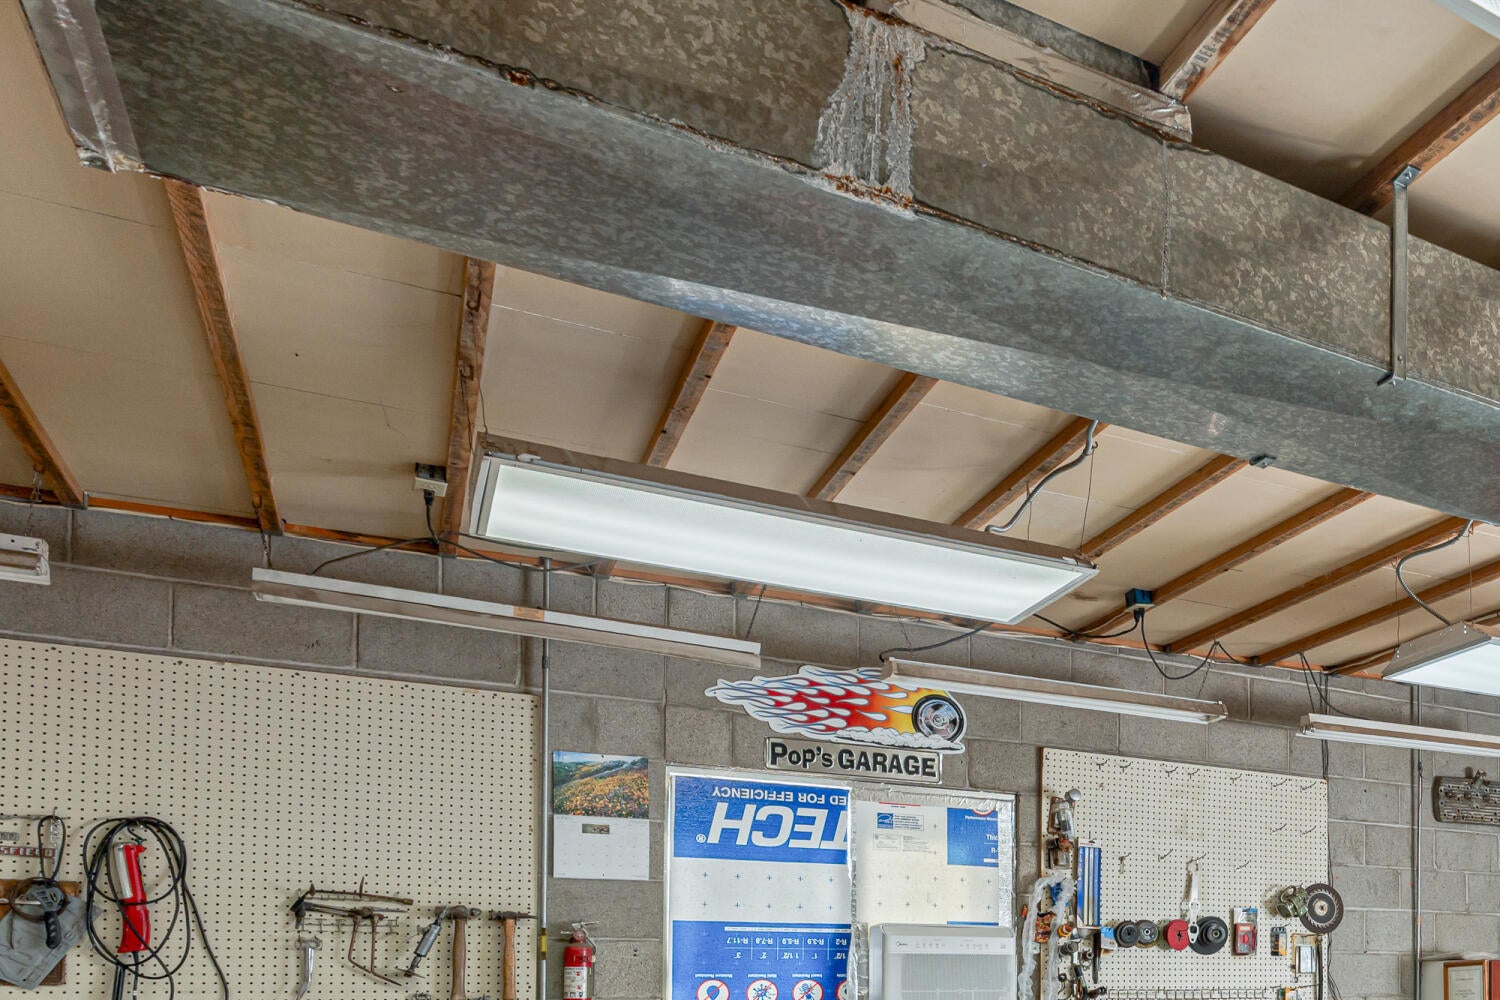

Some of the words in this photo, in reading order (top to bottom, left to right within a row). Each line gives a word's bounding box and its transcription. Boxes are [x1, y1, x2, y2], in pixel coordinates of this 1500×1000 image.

[770, 742, 834, 769] Pop's
[838, 749, 937, 777] GARAGE
[712, 786, 794, 801] EFFICIENCY
[798, 792, 825, 804] FOR
